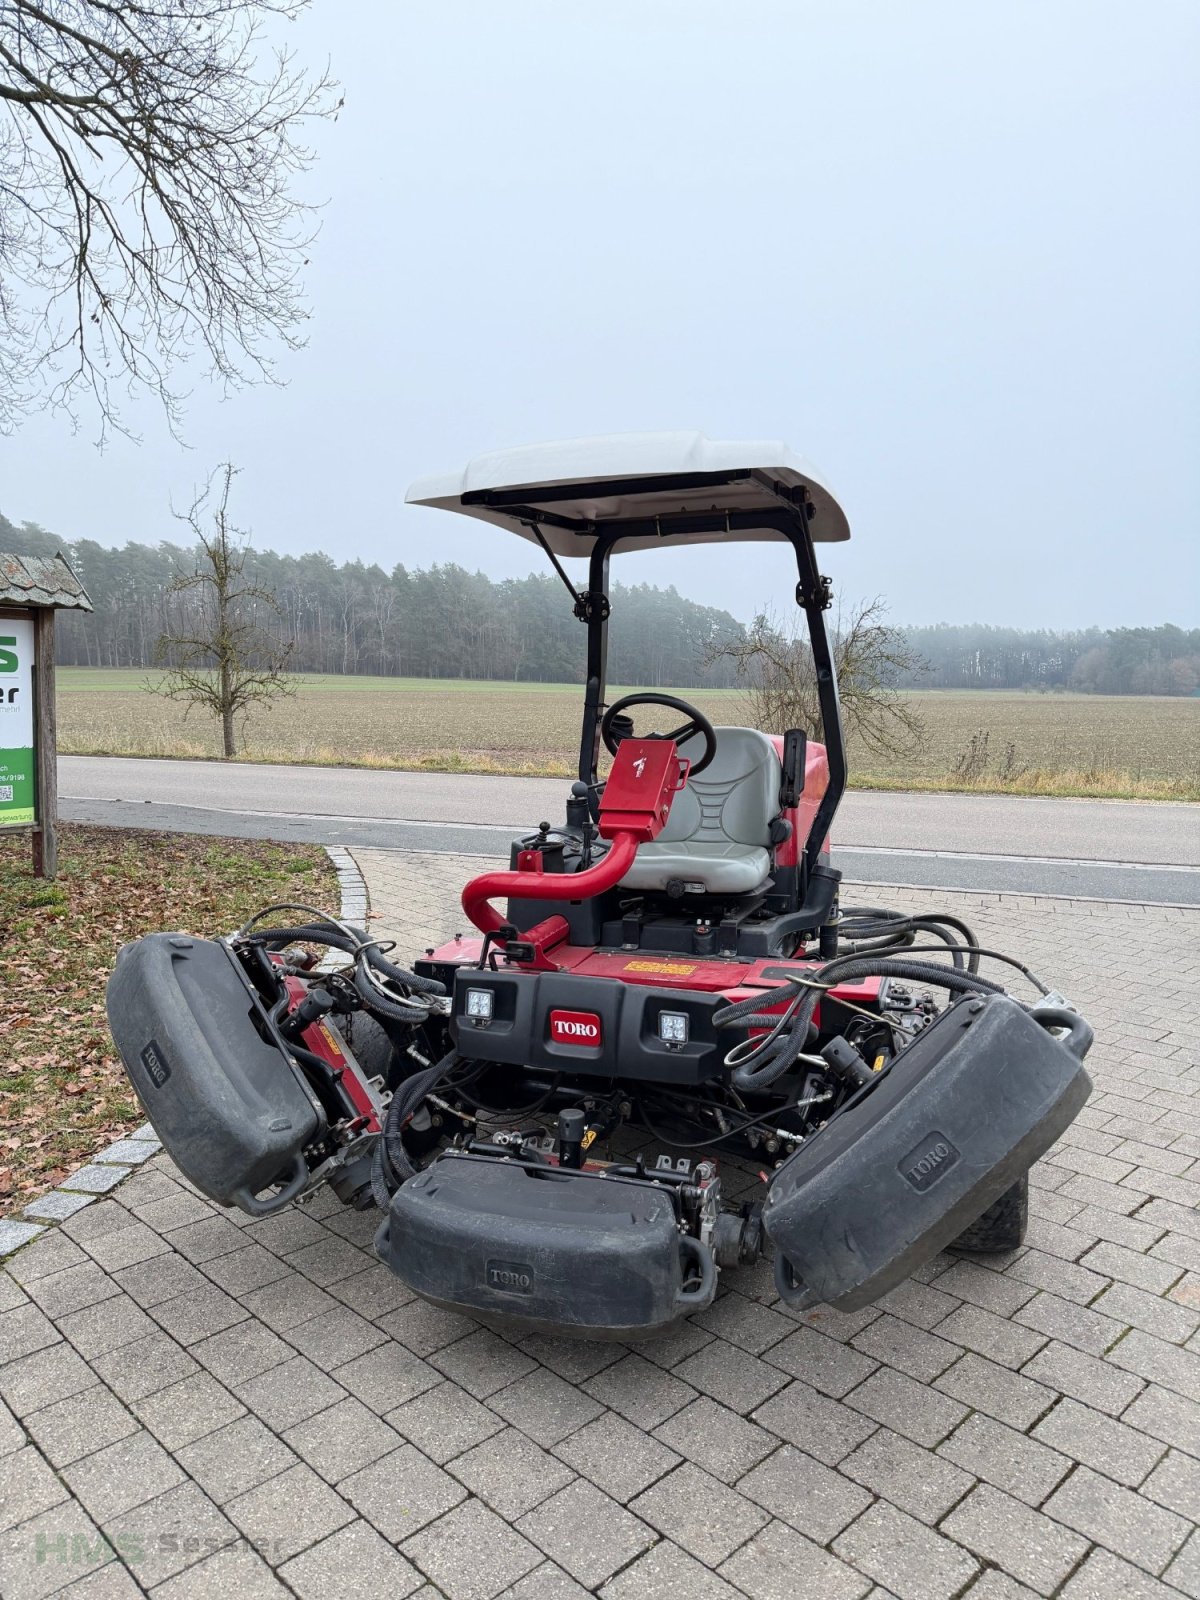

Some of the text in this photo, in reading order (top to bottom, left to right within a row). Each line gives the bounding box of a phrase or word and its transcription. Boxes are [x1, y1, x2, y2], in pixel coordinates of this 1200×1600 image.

[555, 1020, 598, 1037] TORO
[145, 1047, 166, 1082] TORO
[906, 1143, 949, 1181] TORO
[490, 1269, 530, 1287] TORO
